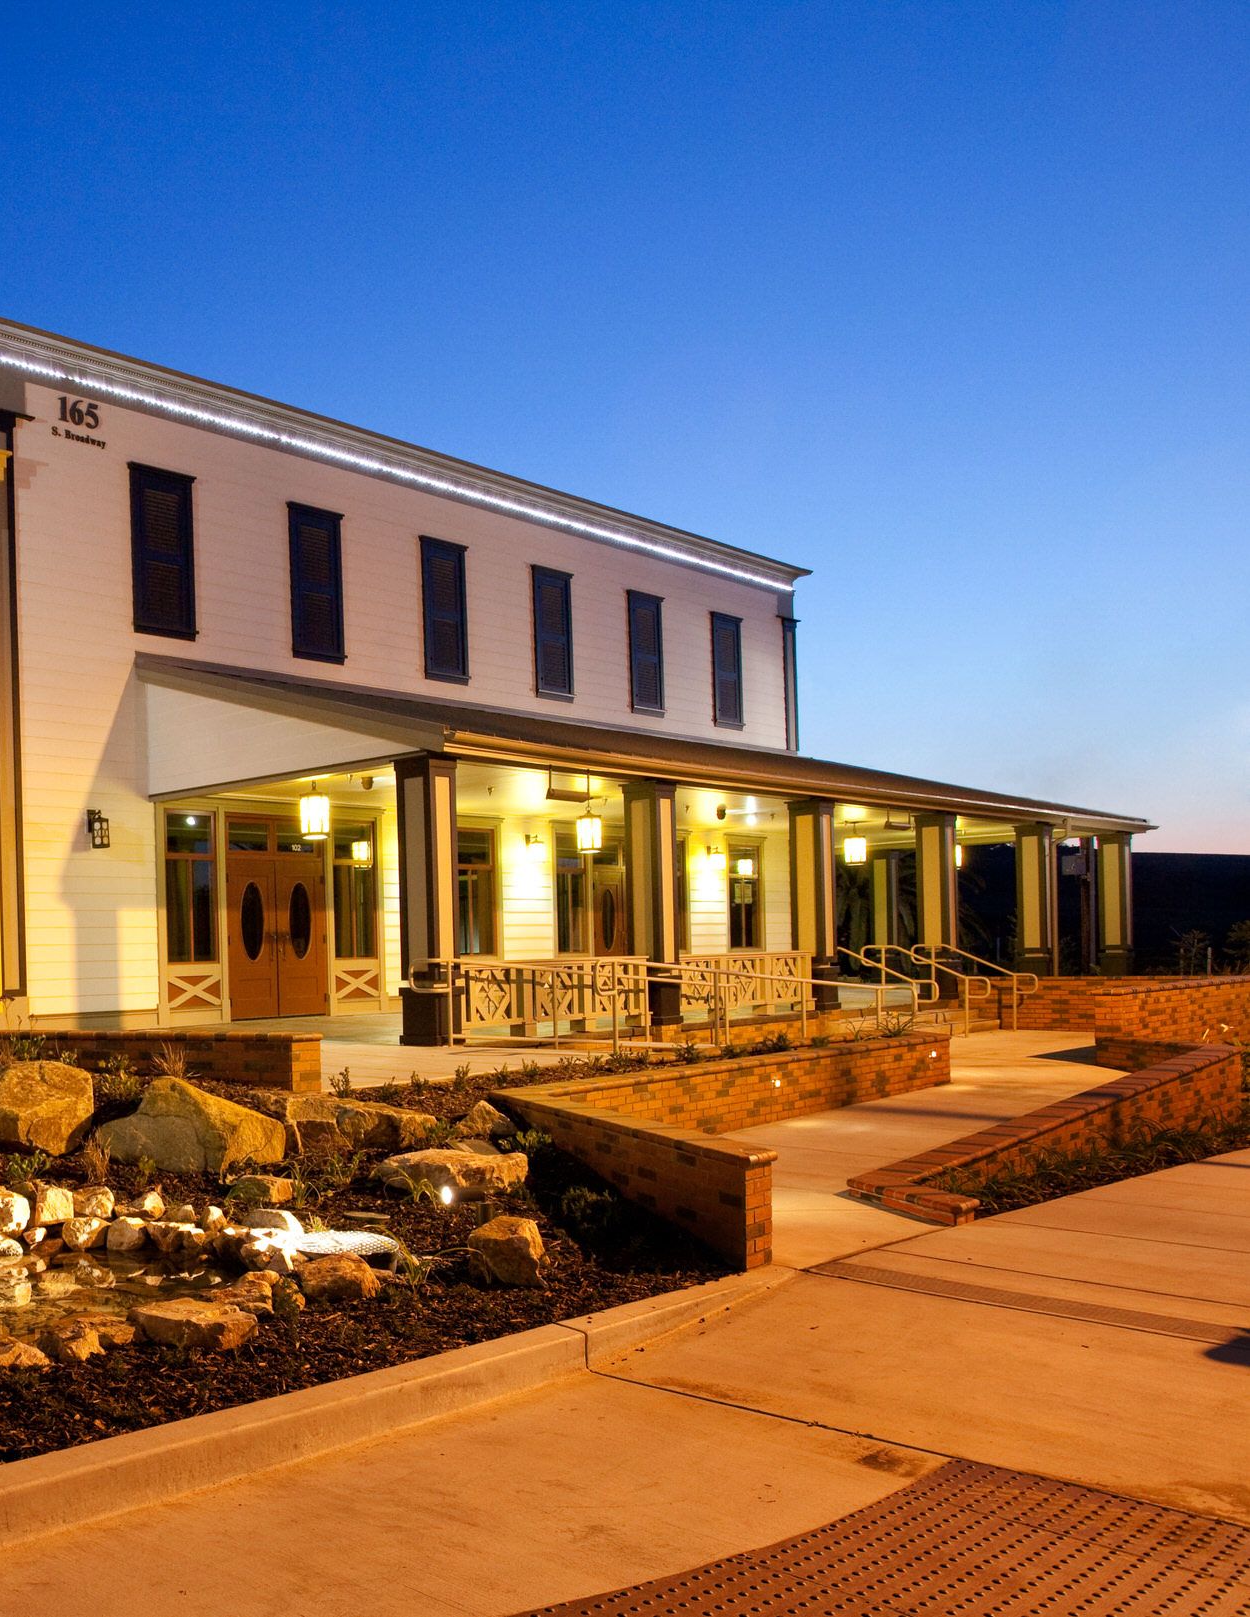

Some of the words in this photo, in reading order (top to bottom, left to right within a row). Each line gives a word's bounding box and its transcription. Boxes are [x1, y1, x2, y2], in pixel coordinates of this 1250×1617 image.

[58, 396, 99, 429] 165
[51, 426, 62, 437] S.
[64, 429, 106, 449] Broadway
